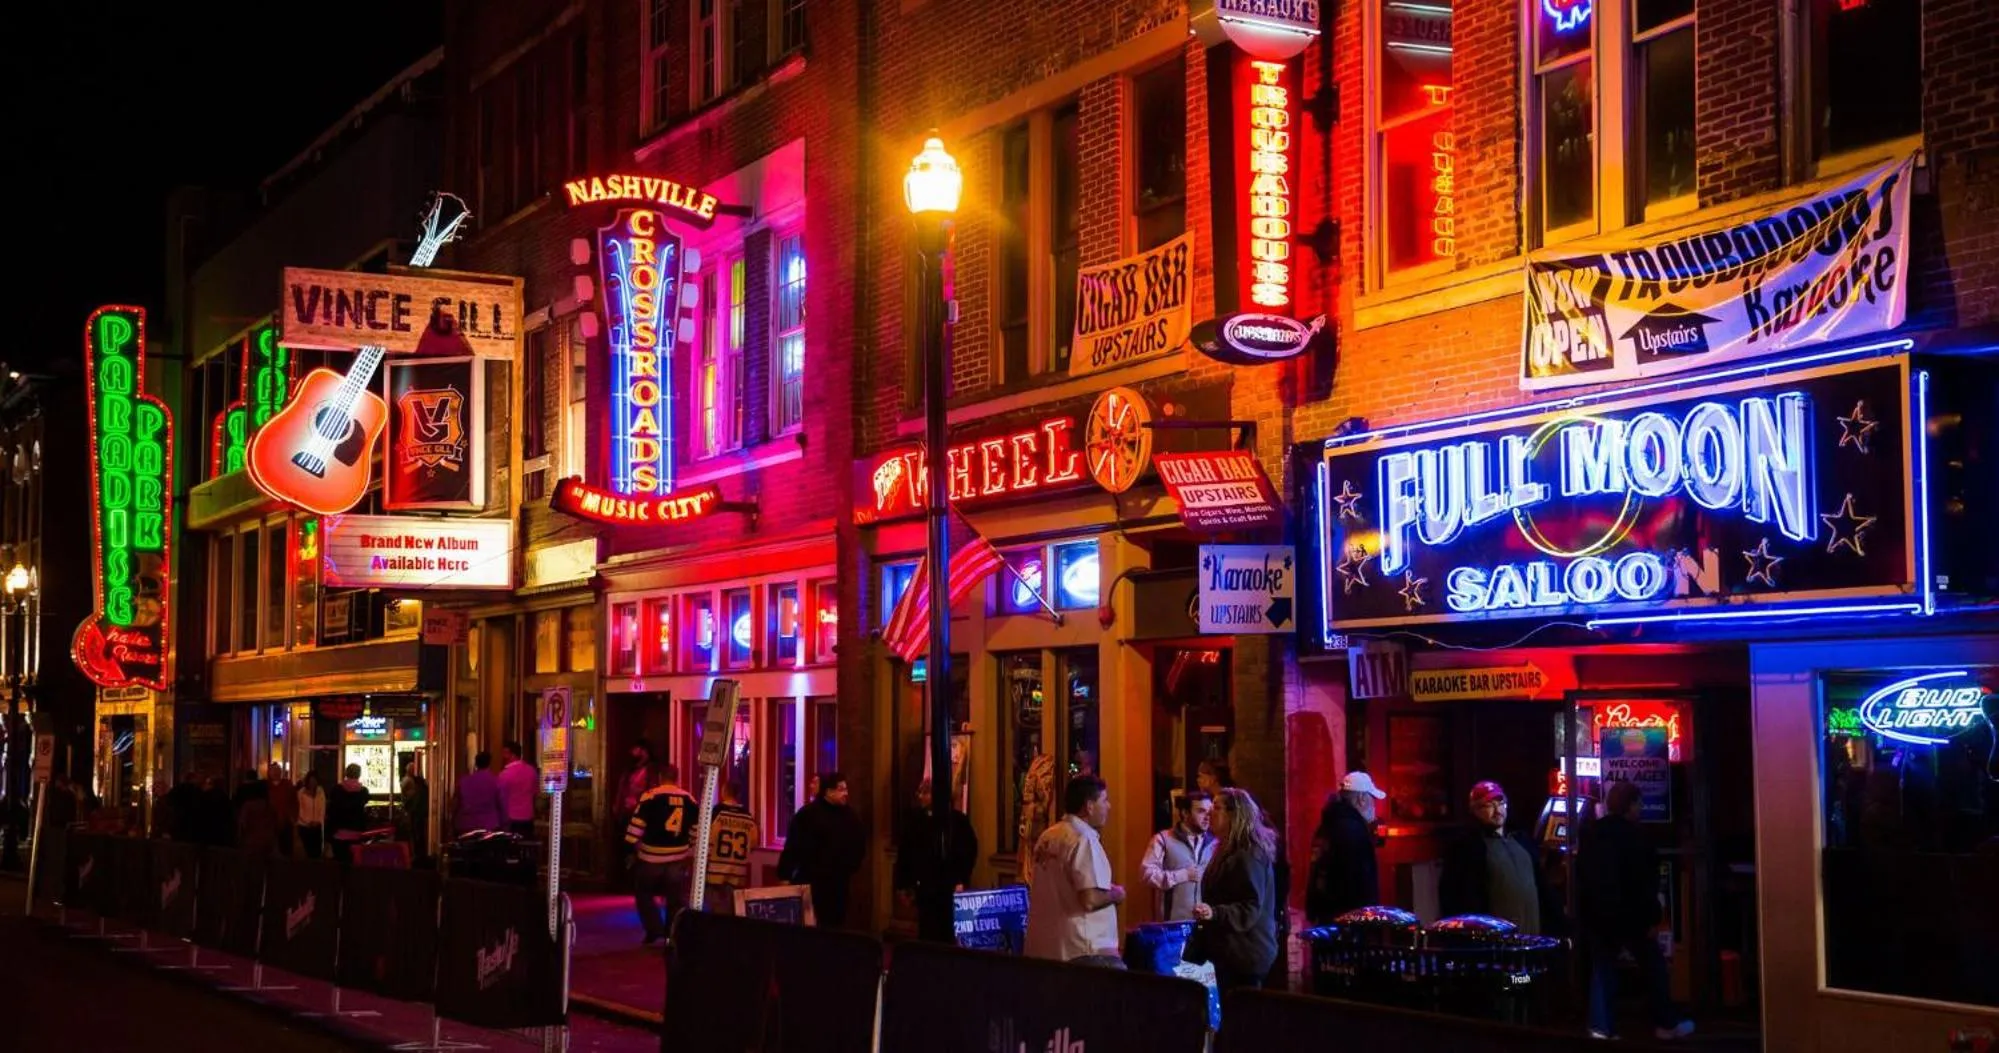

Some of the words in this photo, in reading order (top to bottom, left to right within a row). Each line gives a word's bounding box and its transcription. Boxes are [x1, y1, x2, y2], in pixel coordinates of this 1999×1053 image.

[565, 174, 718, 220] NASHVILLE
[1250, 61, 1290, 306] TROUBADOURS
[1611, 171, 1899, 302] TROUBADOURS
[1077, 264, 1139, 336] CIGAR
[1143, 242, 1188, 317] BAR
[1537, 265, 1601, 315] NOW
[1742, 246, 1895, 345] Karaoke
[291, 284, 412, 333] VINCE
[432, 296, 514, 340] GILL
[628, 210, 662, 492] CROSSROADS
[1091, 318, 1168, 367] UPSTAIRS
[1532, 315, 1609, 370] OPEN
[1638, 324, 1699, 354] Upstairs
[100, 315, 132, 626] PARADISE
[134, 404, 163, 549] PARK
[1160, 459, 1219, 484] CIGAR
[1216, 455, 1259, 481] BAR
[1378, 434, 1550, 576] FULL
[1560, 391, 1818, 542] MOON
[1183, 485, 1259, 504] UPSTAIRS
[360, 534, 401, 549] Brand
[405, 535, 433, 549] New
[437, 536, 478, 550] Album
[371, 555, 435, 571] Available
[438, 557, 469, 572] Here
[1210, 552, 1283, 595] Karaoke
[1447, 548, 1721, 612] SALOON
[1210, 604, 1263, 625] UPSTAIRS
[1355, 652, 1405, 697] ATM
[1414, 676, 1467, 695] KARAOKE
[1470, 674, 1490, 692] BAR
[1493, 671, 1542, 690] UPSTAIRS
[1875, 708, 1983, 728] LIGHT
[1896, 686, 1981, 707] BUD
[1605, 770, 1629, 782] ALL
[1632, 769, 1666, 782] AGES
[1608, 759, 1660, 769] WELCOME
[664, 806, 683, 837] 4
[716, 829, 748, 861] 63
[953, 919, 974, 934] 2ND
[974, 917, 1001, 931] LEVEL
[1511, 971, 1532, 984] Trash
